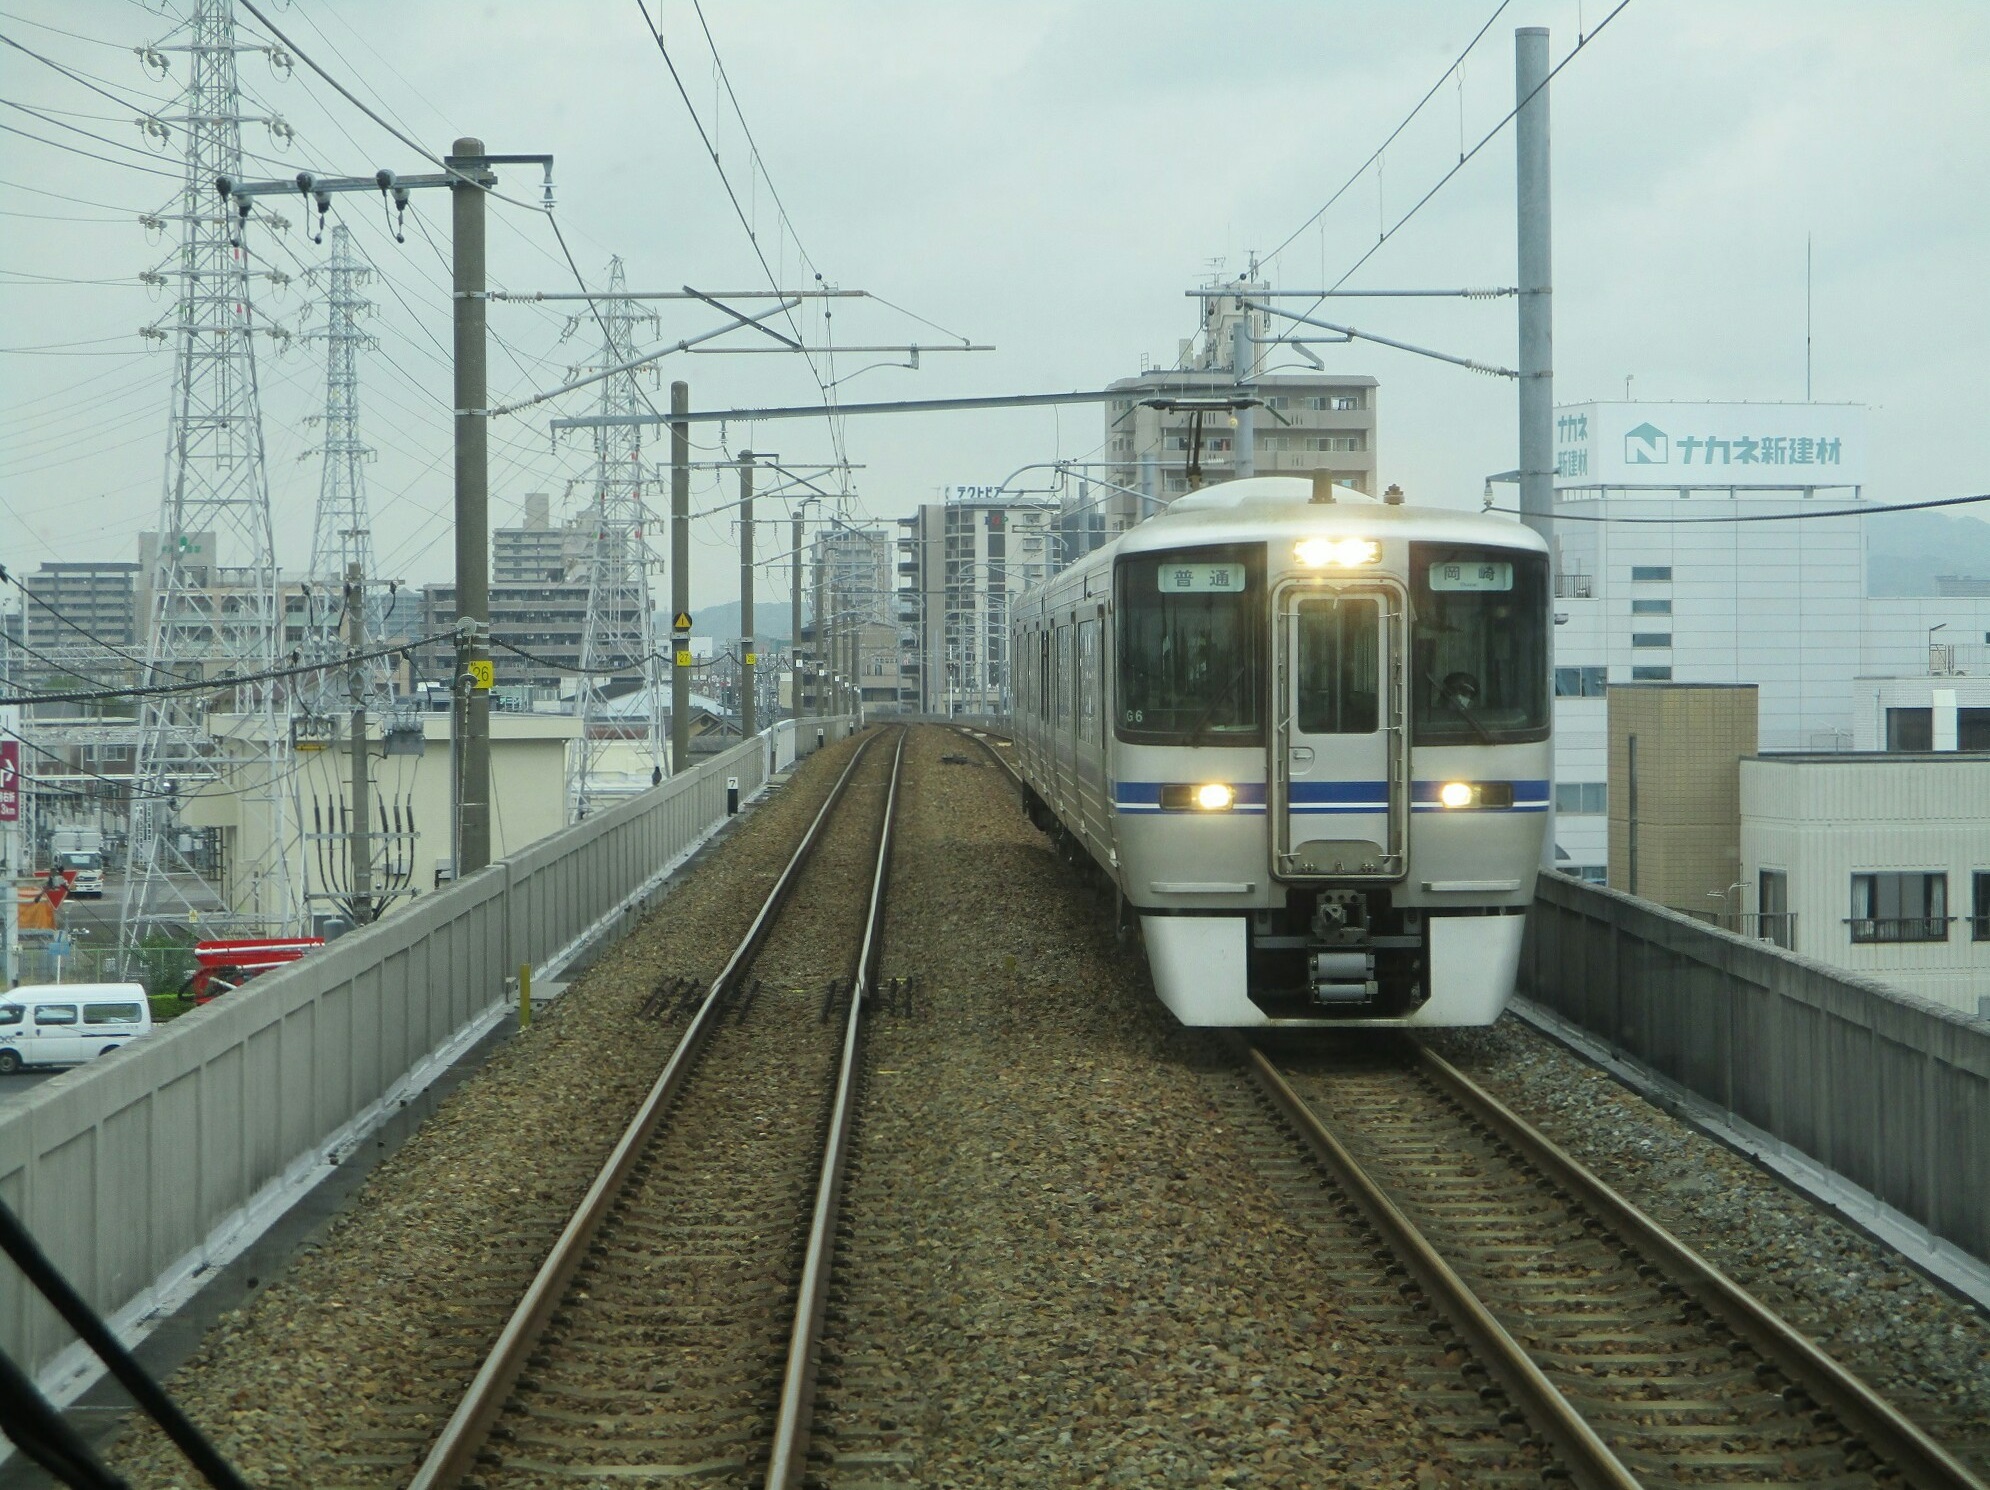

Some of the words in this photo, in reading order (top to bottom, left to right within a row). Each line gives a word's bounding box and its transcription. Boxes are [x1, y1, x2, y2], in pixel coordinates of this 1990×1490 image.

[1558, 412, 1588, 443] ナカネ
[1676, 435, 1842, 465] ナカネ新建材
[1558, 448, 1588, 478] 新建材
[1174, 569, 1230, 587] 普通
[1444, 565, 1496, 581] 岡崎
[472, 665, 489, 682] 26
[1126, 709, 1143, 723] G6
